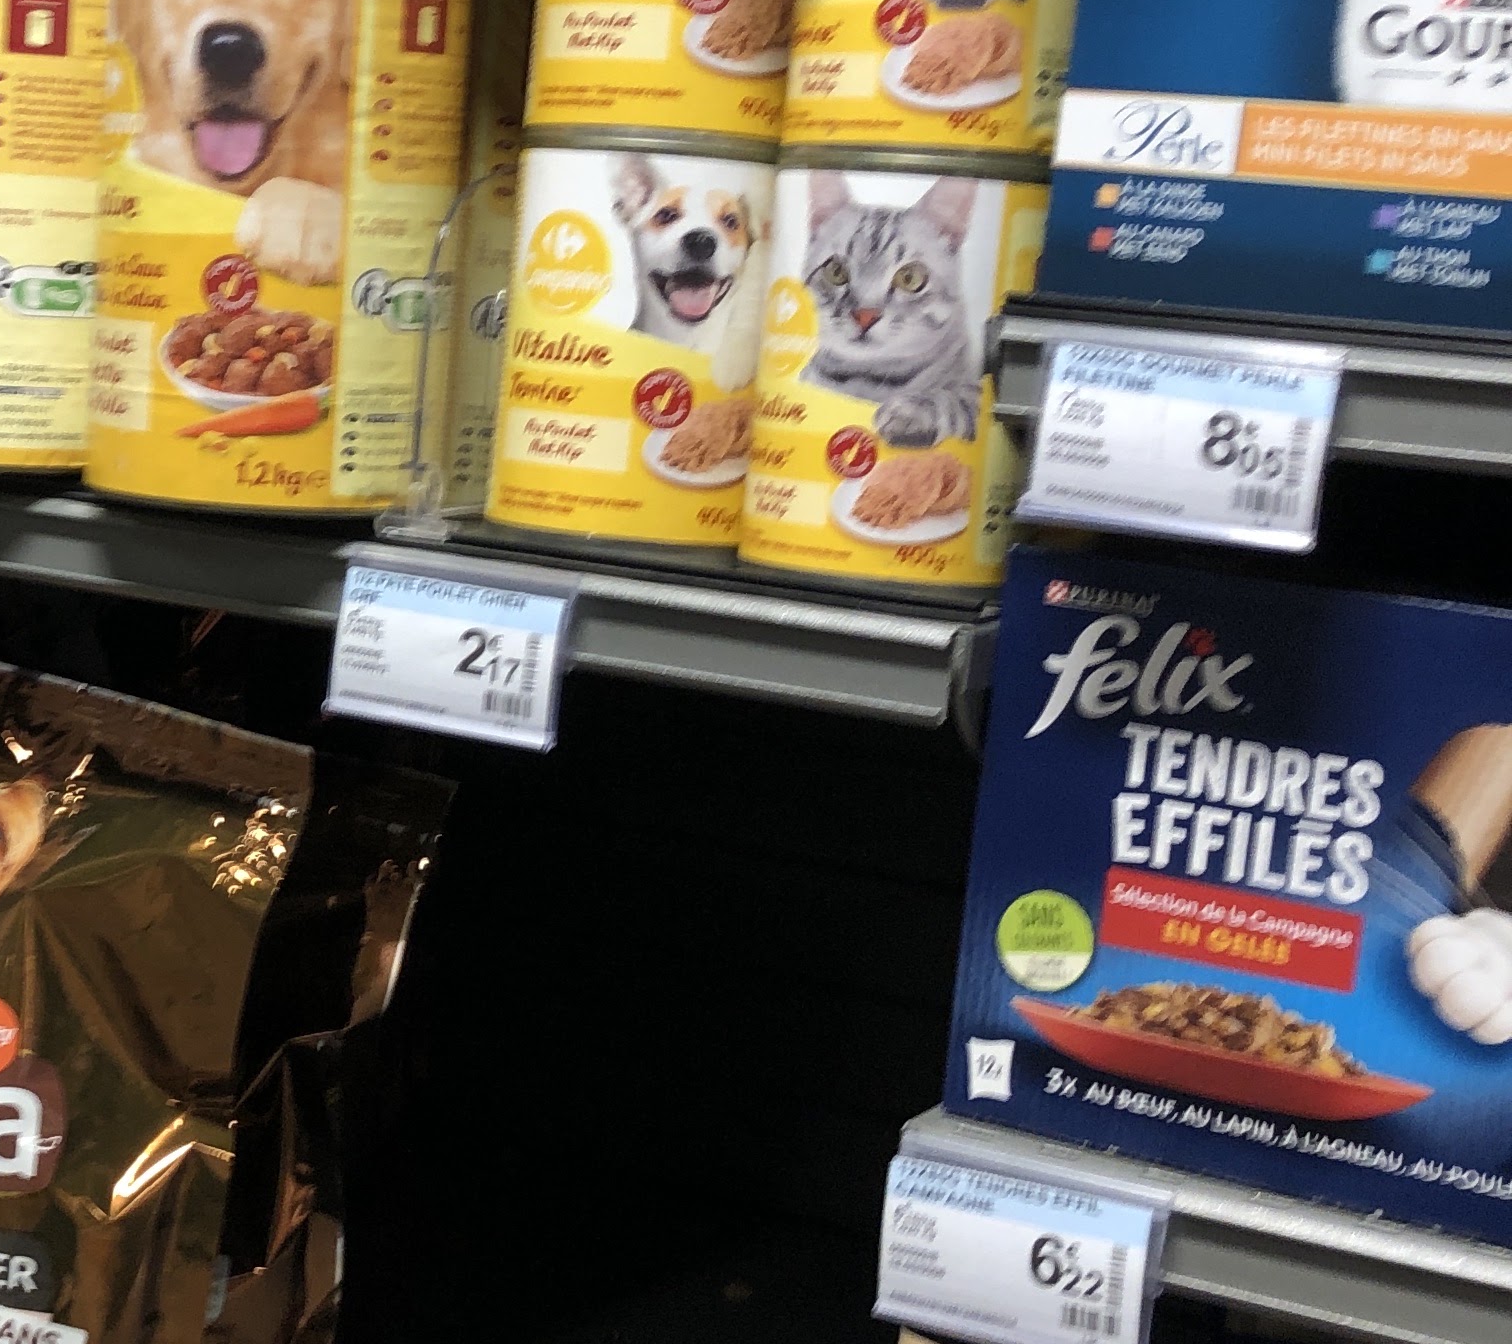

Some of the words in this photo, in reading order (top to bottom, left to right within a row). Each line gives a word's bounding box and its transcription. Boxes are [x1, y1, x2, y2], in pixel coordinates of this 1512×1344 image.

[1102, 99, 1224, 169] Perle
[454, 627, 522, 686] 2€17
[1024, 614, 1254, 740] felix
[1119, 721, 1386, 829] TENDRES
[1111, 792, 1377, 906] EFFILÉS
[1248, 908, 1355, 950] Campagne
[1029, 1232, 1104, 1302] 6€22
